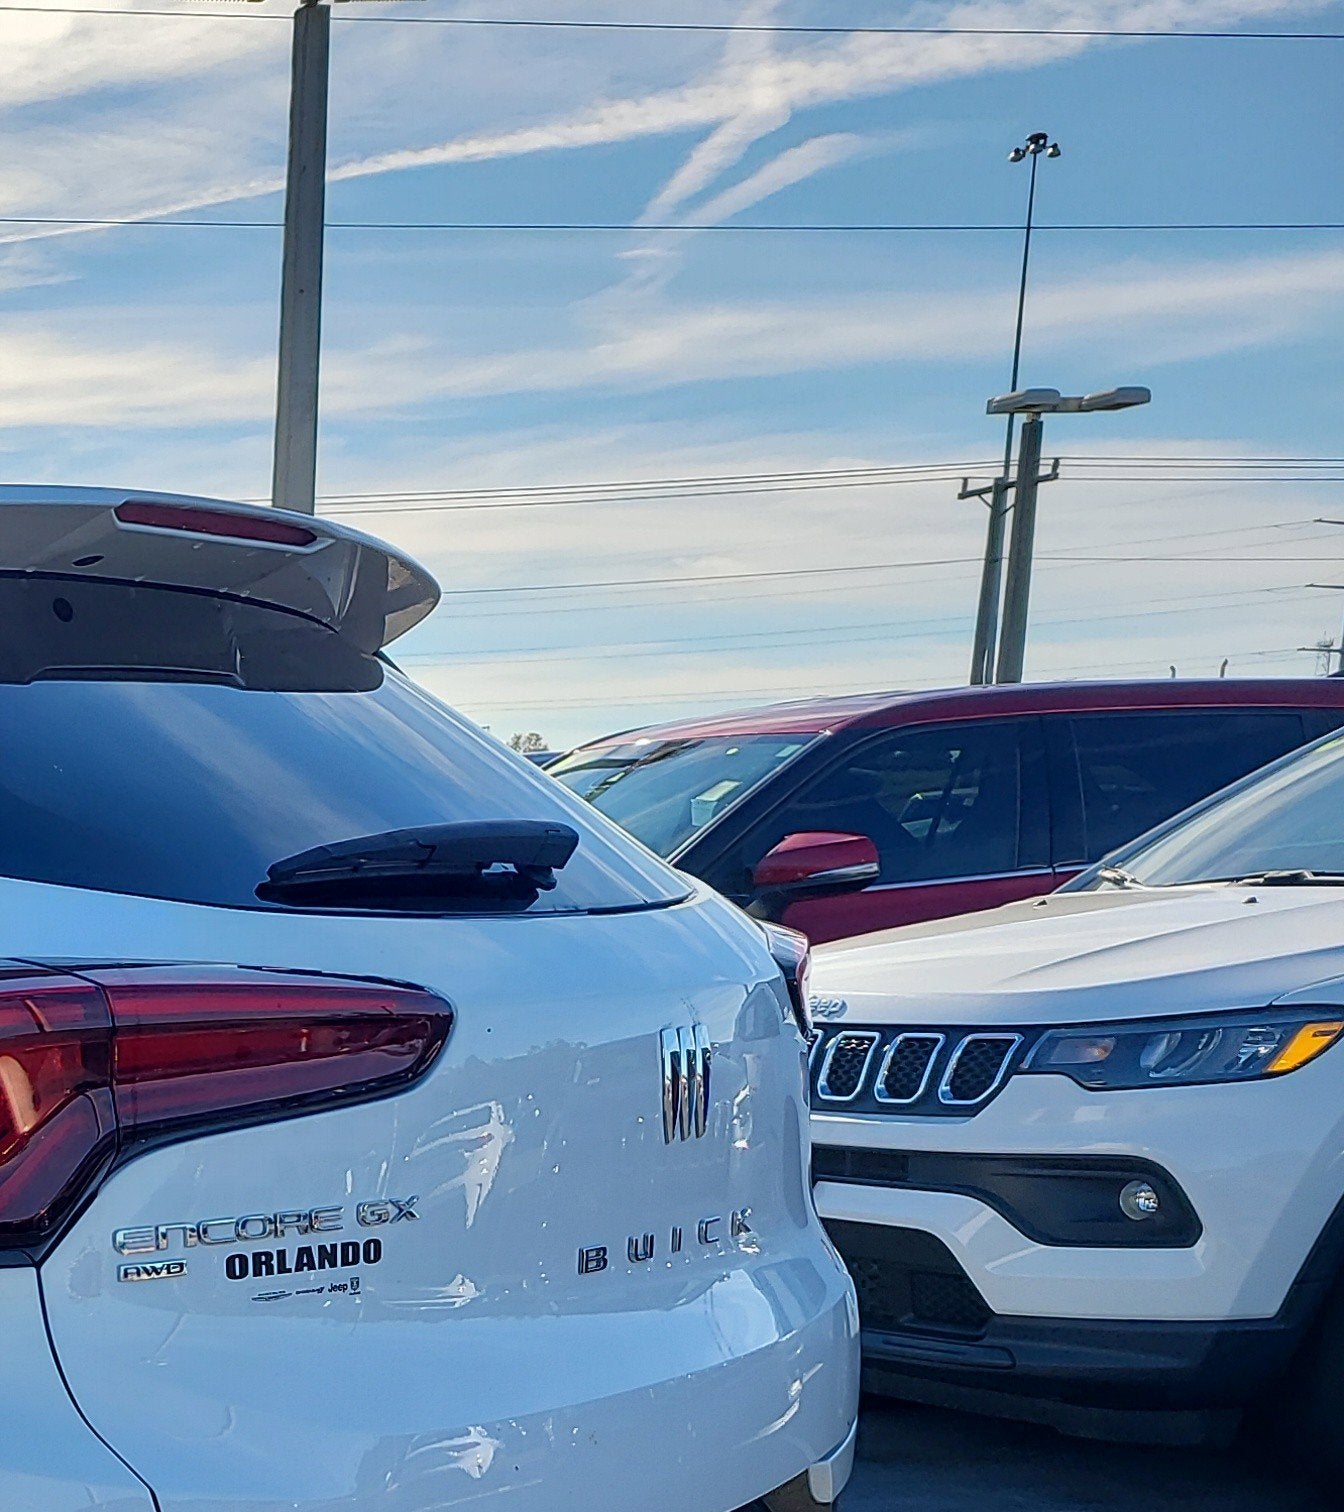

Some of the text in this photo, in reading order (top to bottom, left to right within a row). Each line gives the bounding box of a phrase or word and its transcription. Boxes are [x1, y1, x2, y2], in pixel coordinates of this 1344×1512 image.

[808, 996, 847, 1019] eep
[113, 1195, 420, 1255] ENCORE GX
[578, 1206, 753, 1275] BUICK
[120, 1260, 185, 1281] AWD
[225, 1238, 382, 1280] ORLANDO
[328, 1283, 348, 1293] Jeep
